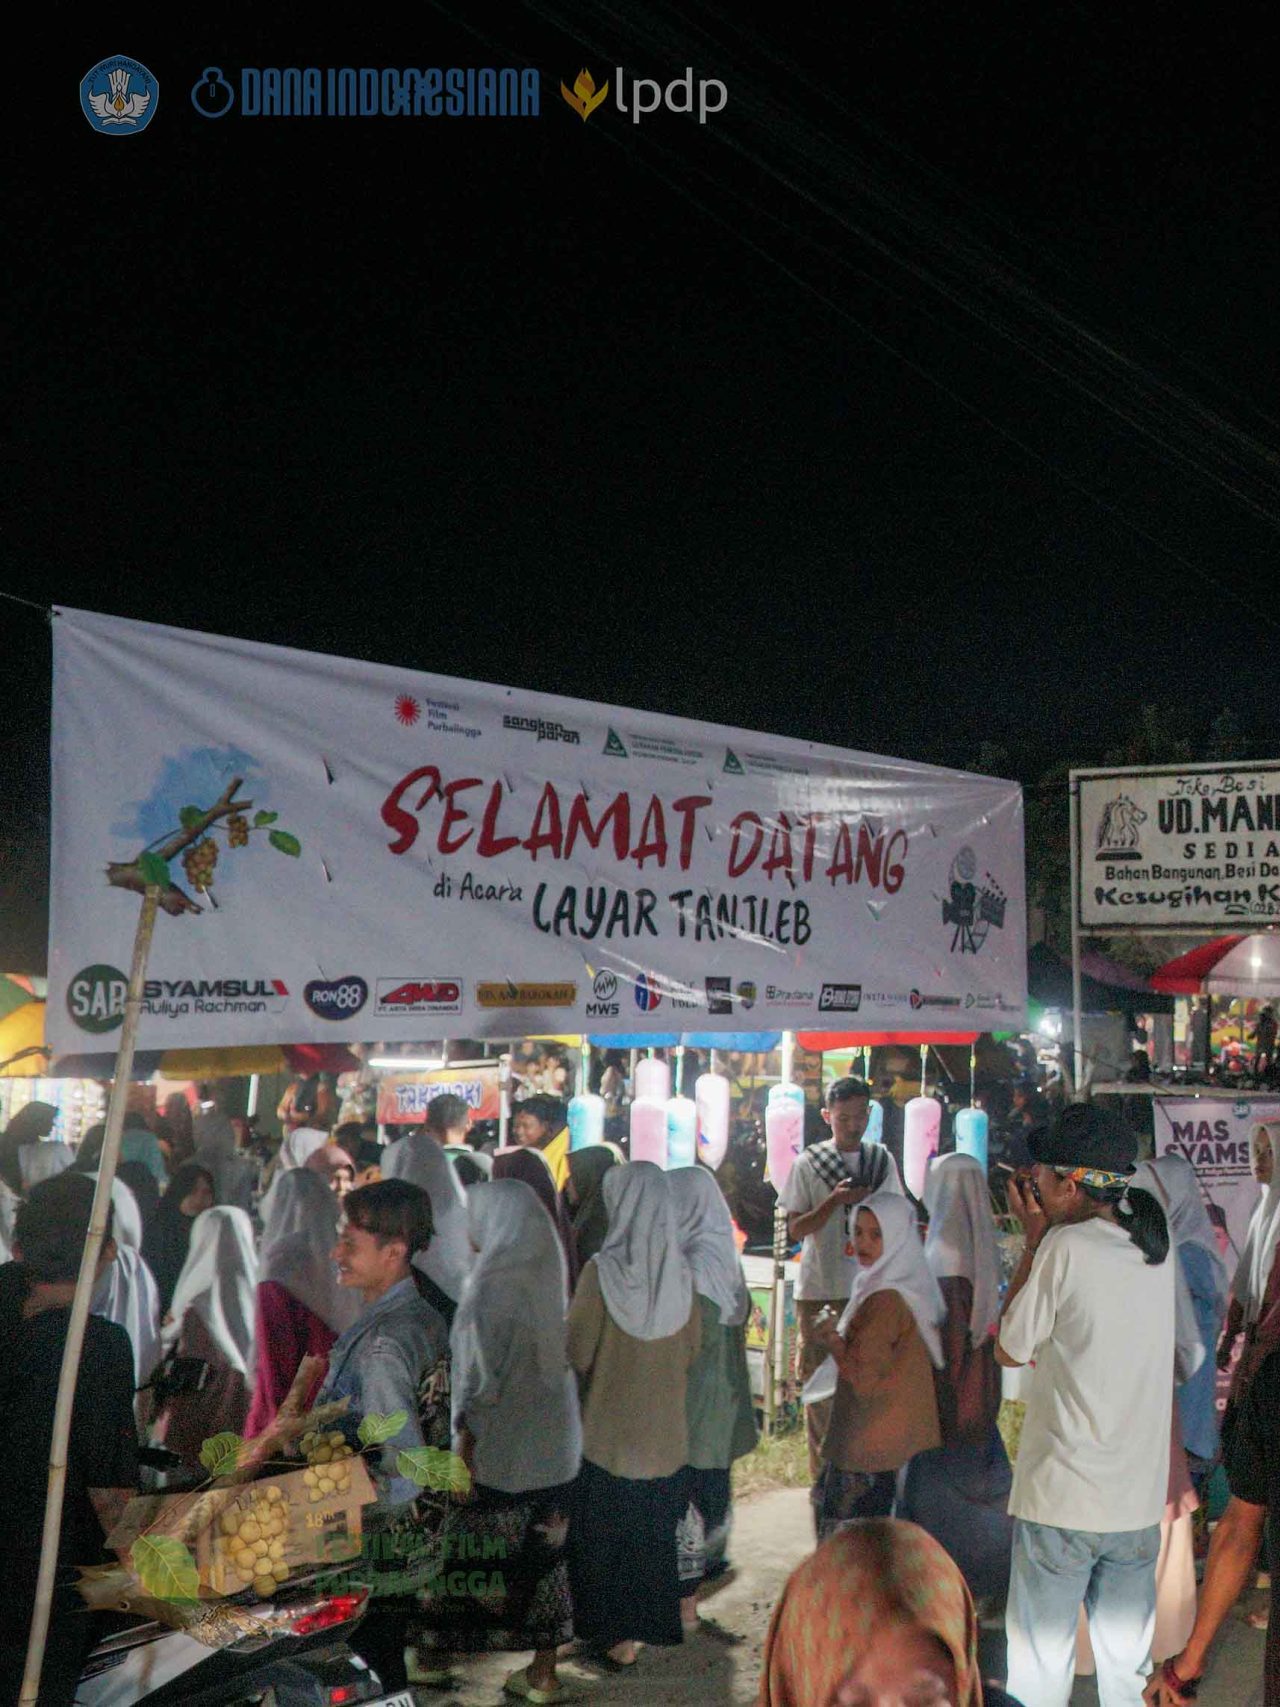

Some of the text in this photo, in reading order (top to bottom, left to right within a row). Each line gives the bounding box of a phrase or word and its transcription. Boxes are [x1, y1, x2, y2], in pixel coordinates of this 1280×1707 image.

[502, 714, 565, 733] sangkan
[536, 728, 581, 745] paran
[380, 765, 713, 873] SELAMAT
[727, 809, 909, 894] DATANG
[1105, 865, 1149, 881] Bahan
[1226, 861, 1256, 879] Besi
[433, 872, 454, 899] di
[461, 872, 524, 903] Acara
[532, 882, 659, 940] LAYAR
[1094, 885, 1251, 908] Kesugihan
[72, 980, 127, 1016] SAR
[143, 980, 275, 998] SYAMSUL
[194, 1000, 267, 1013] Rachman
[1172, 1120, 1229, 1142] MAS
